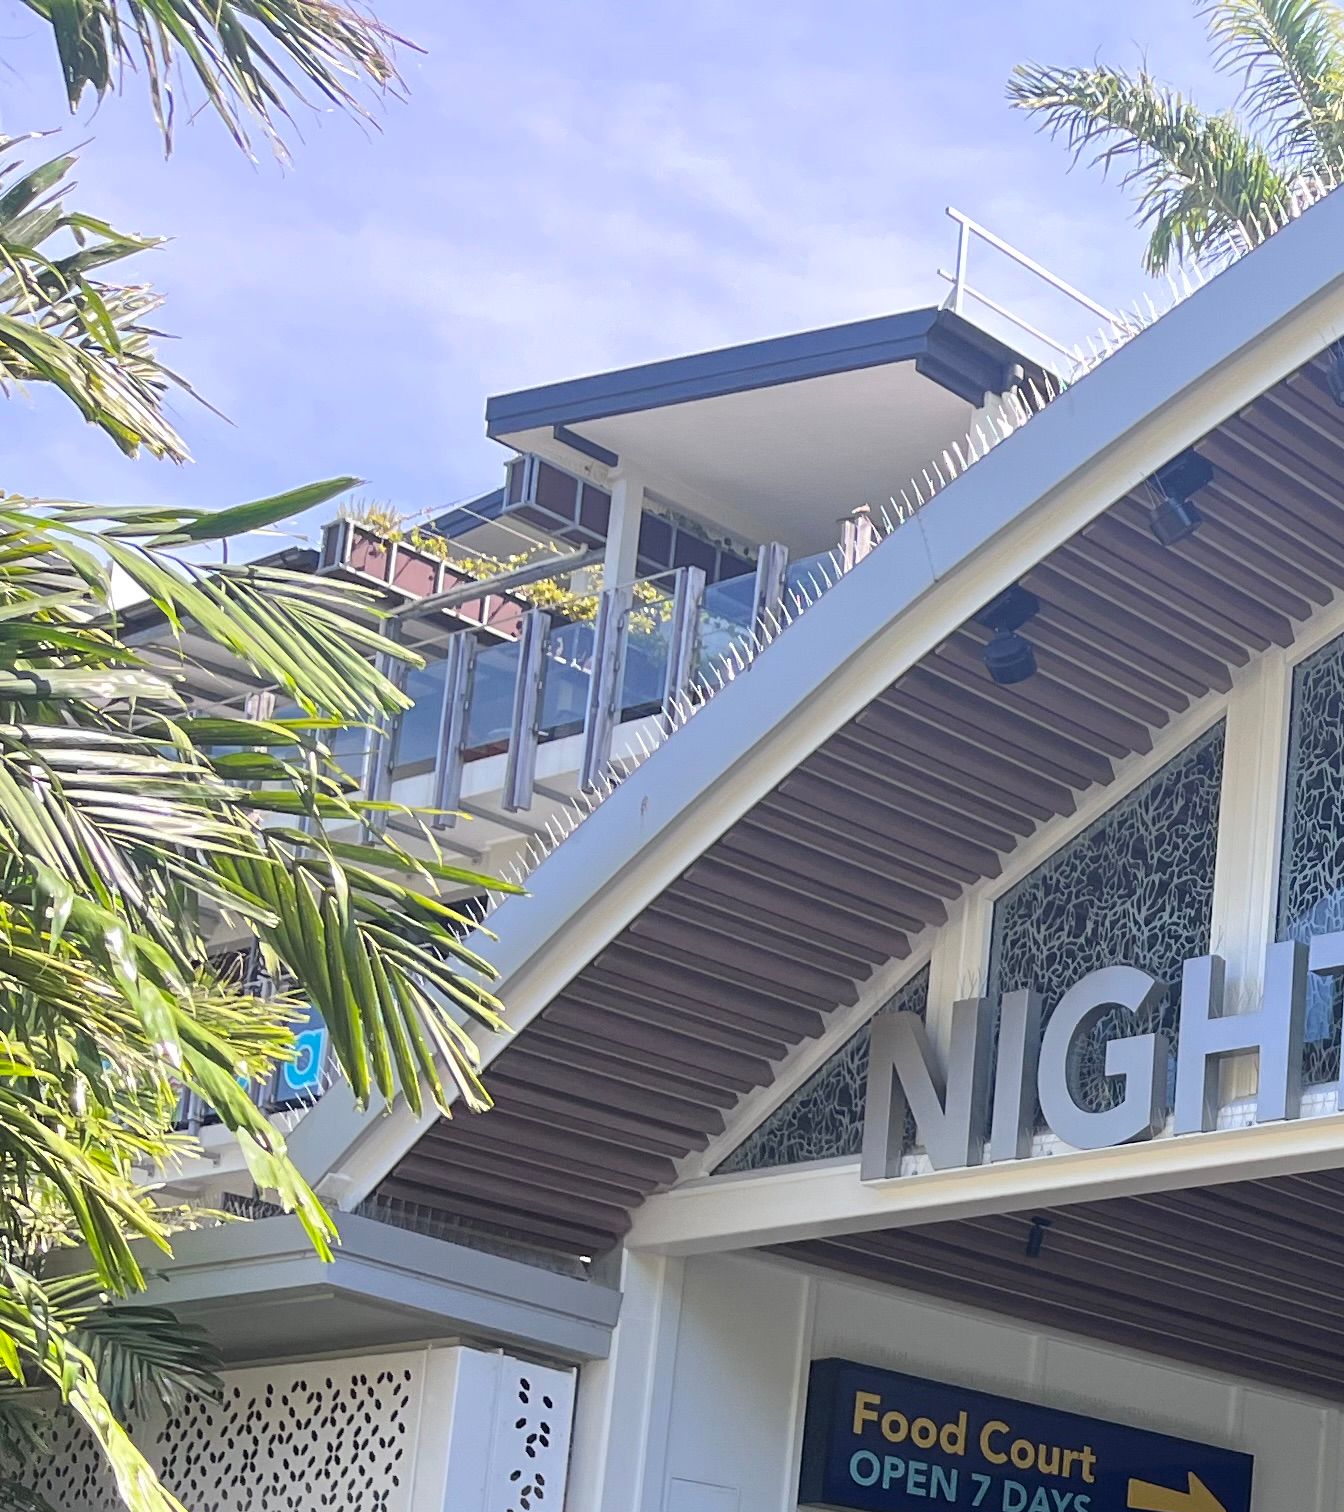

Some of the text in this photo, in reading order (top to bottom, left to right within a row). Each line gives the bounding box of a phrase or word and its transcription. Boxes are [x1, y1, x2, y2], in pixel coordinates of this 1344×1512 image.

[853, 1390, 1097, 1483] Food Court
[849, 1449, 958, 1503] OPEN
[970, 1473, 992, 1507] 7
